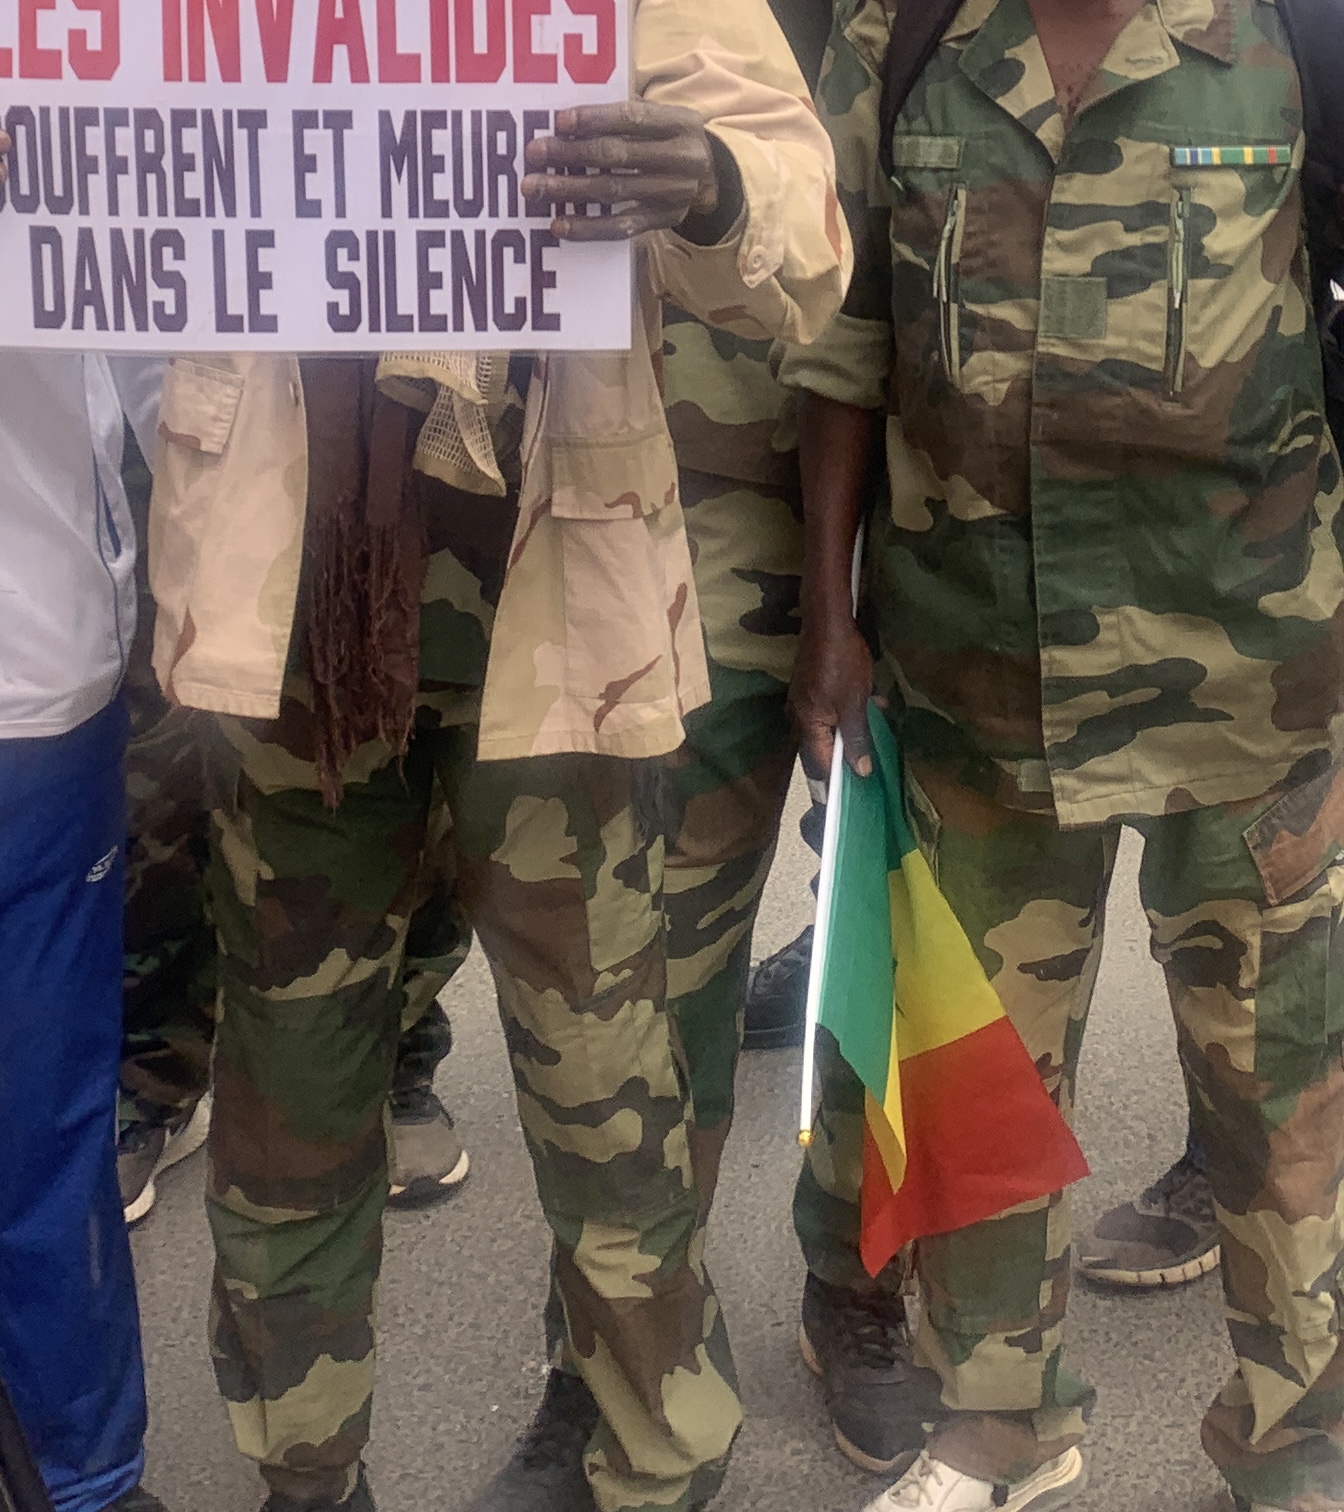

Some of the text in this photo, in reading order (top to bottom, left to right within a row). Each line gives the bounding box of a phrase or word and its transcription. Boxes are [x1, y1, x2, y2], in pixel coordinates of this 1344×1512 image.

[291, 108, 354, 219] ET
[378, 109, 614, 219] MEURE
[29, 227, 561, 334] DANS LE SILENCE
